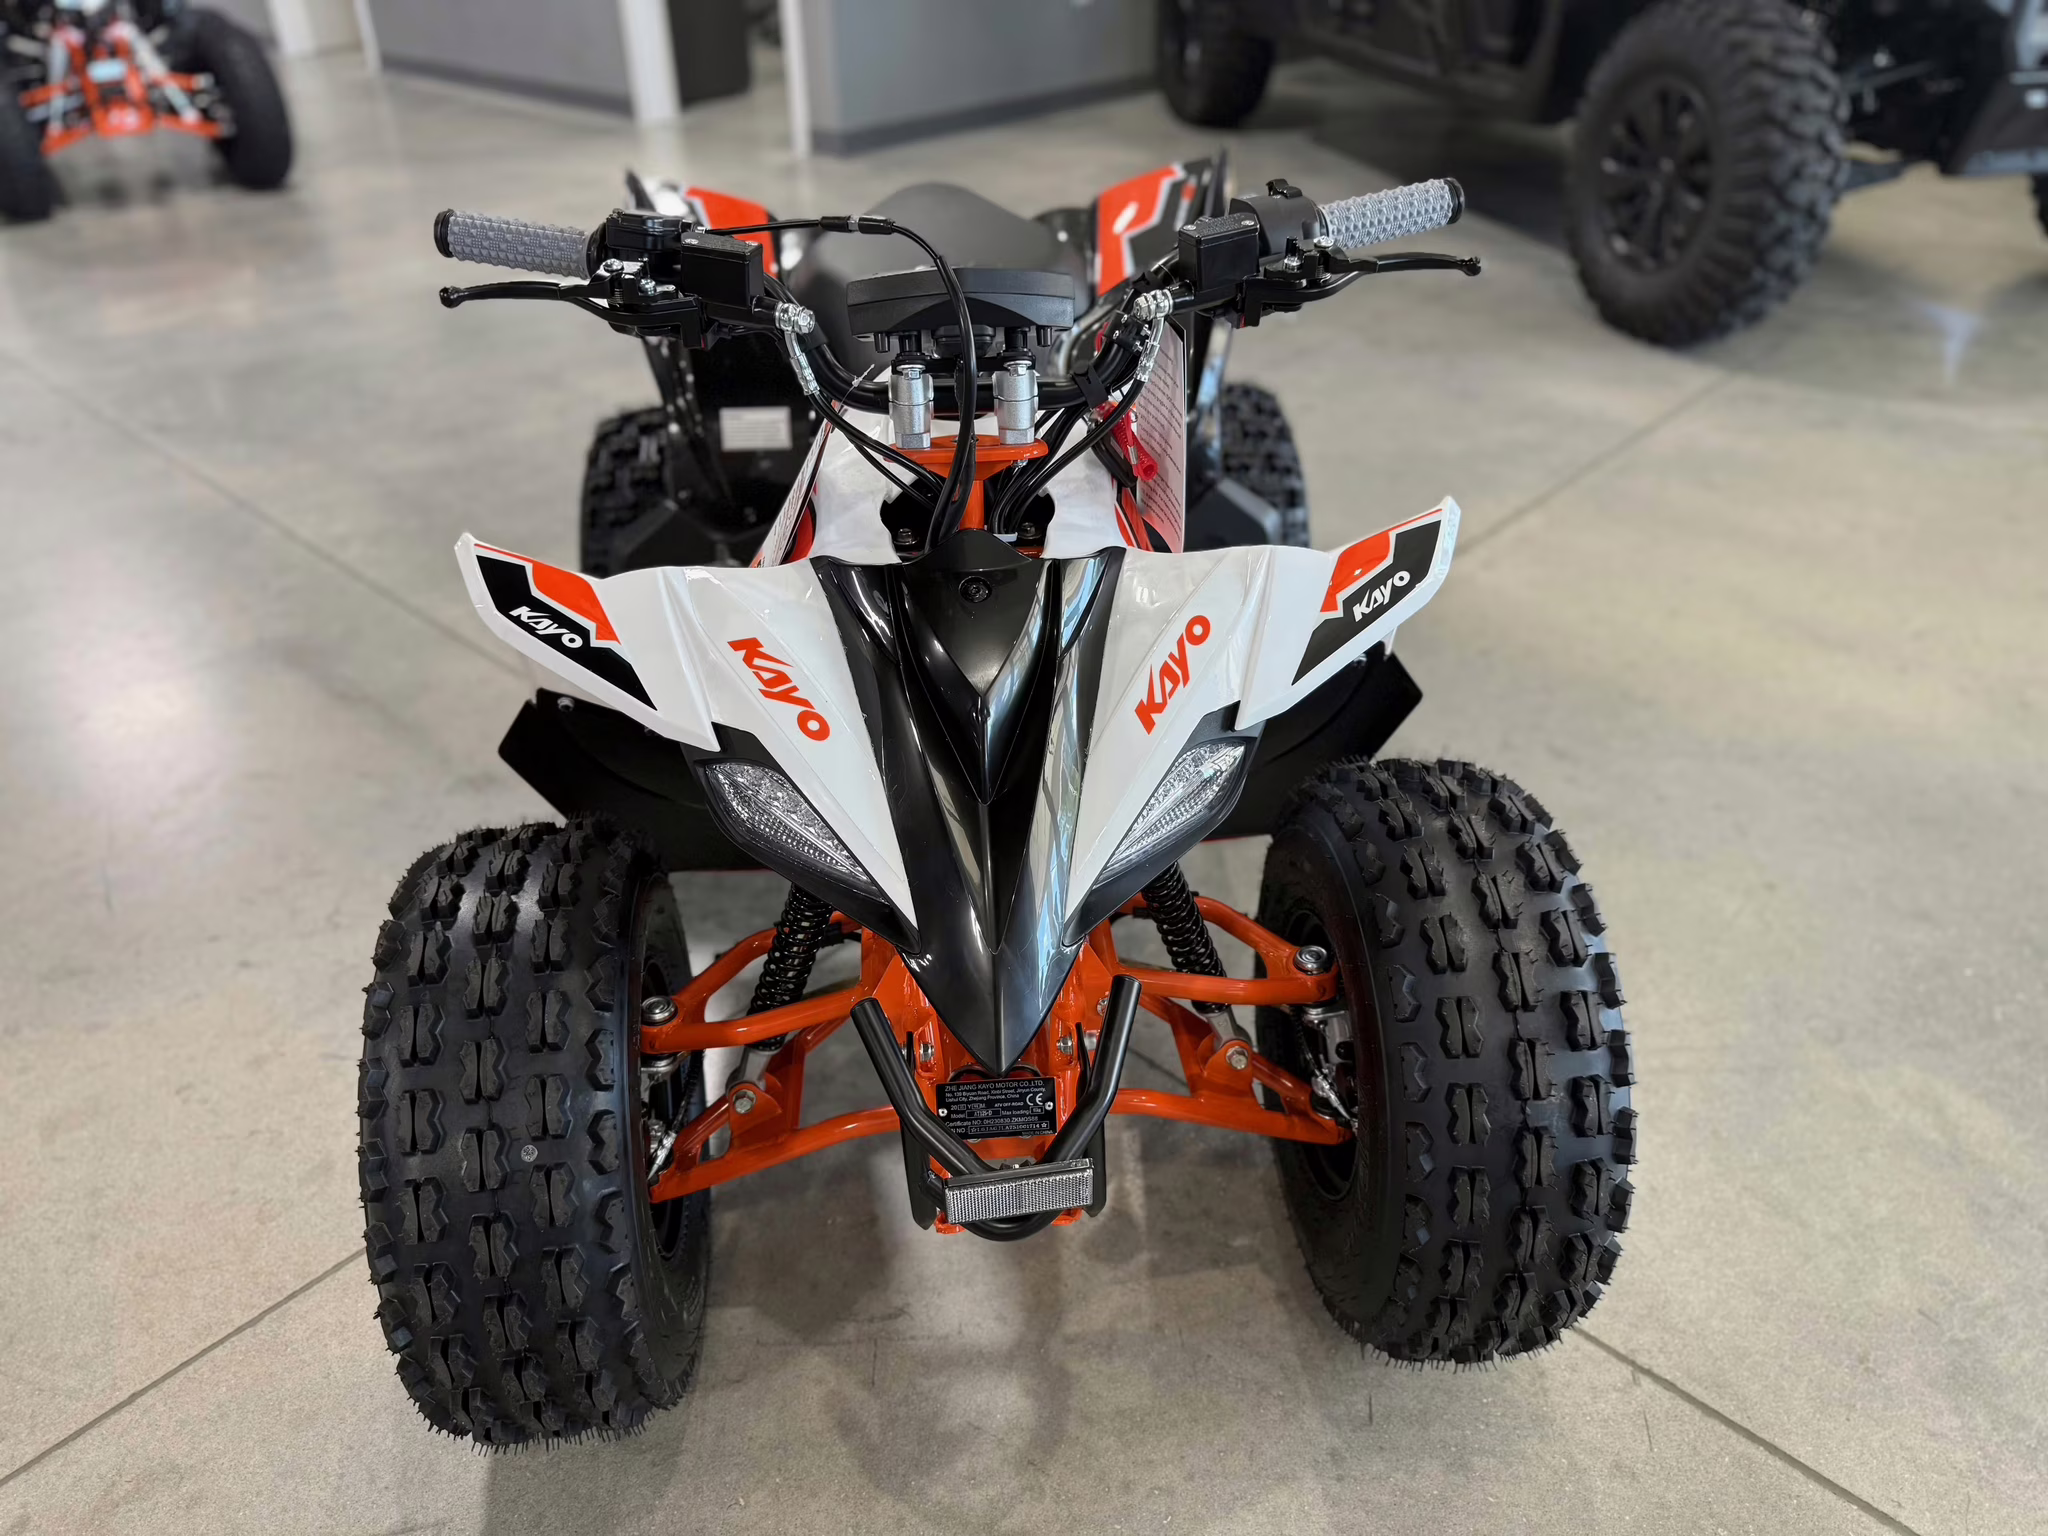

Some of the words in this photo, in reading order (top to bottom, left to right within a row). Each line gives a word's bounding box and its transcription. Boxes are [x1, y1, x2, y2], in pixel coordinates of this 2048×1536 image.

[1353, 571, 1410, 622] KAYO
[509, 606, 583, 648] KAYO
[727, 637, 831, 741] KAYO
[1135, 615, 1211, 735] KAYO
[1026, 1092, 1044, 1106] CE
